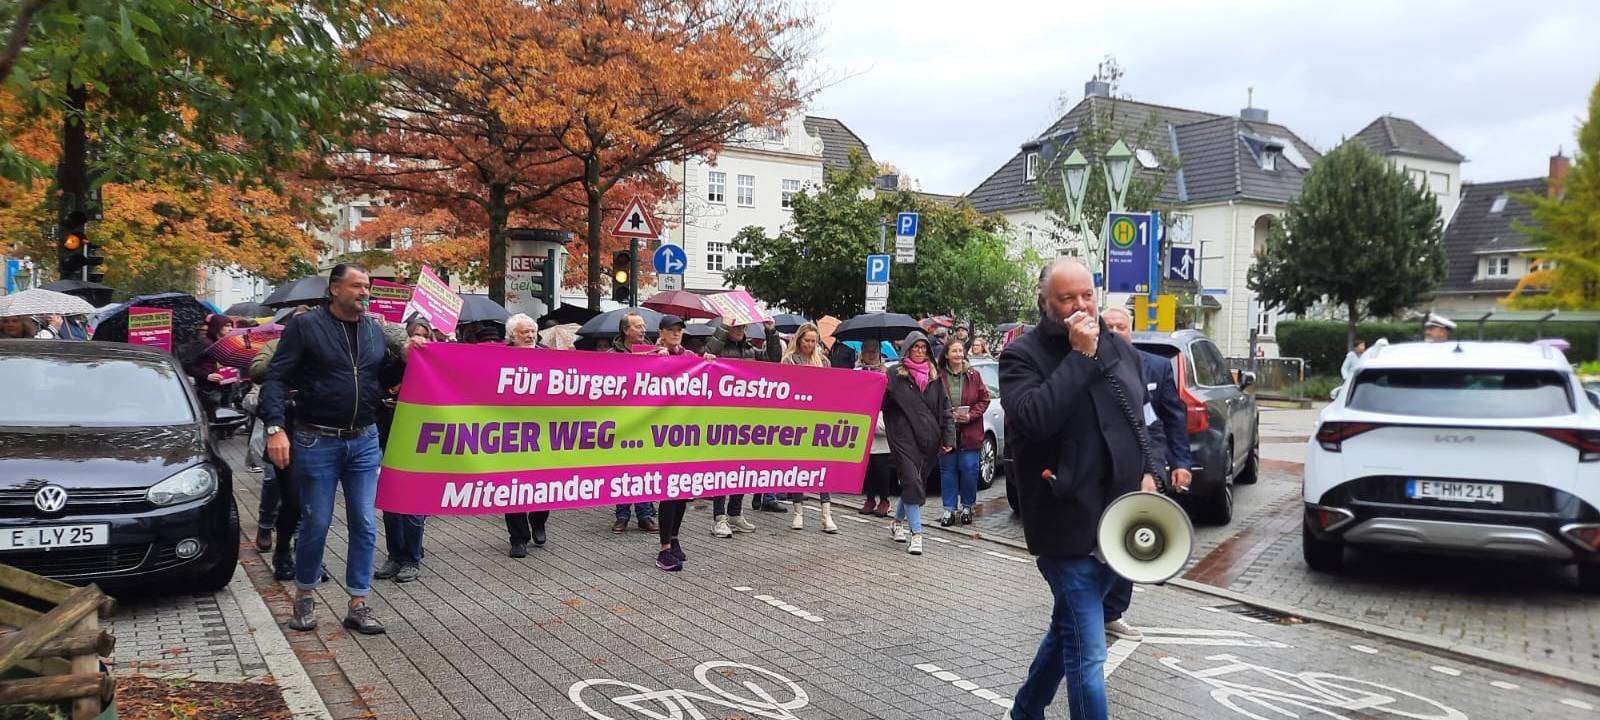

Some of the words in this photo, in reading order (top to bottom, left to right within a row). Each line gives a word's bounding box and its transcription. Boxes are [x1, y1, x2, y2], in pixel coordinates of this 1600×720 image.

[901, 216, 912, 234] P
[1118, 223, 1129, 242] H
[1138, 221, 1147, 246] 1
[512, 257, 549, 270] REW
[872, 258, 884, 280] P
[496, 366, 543, 395] Für
[547, 368, 628, 400] Bürger,
[632, 372, 712, 399] Handel,
[718, 375, 790, 400] Gastro
[416, 421, 541, 455] FINGER
[549, 421, 616, 451] WEG
[651, 423, 700, 447] von
[706, 424, 808, 446] unserer
[812, 419, 859, 449] RÜ!
[440, 474, 604, 508] Miteinander
[610, 470, 662, 498] statt
[667, 464, 827, 498] gegeneinander!
[1422, 482, 1430, 495] E
[1442, 483, 1463, 497] HM
[1465, 484, 1495, 499] 214
[12, 530, 24, 546] E
[40, 528, 64, 545] LY
[70, 527, 94, 543] 25
